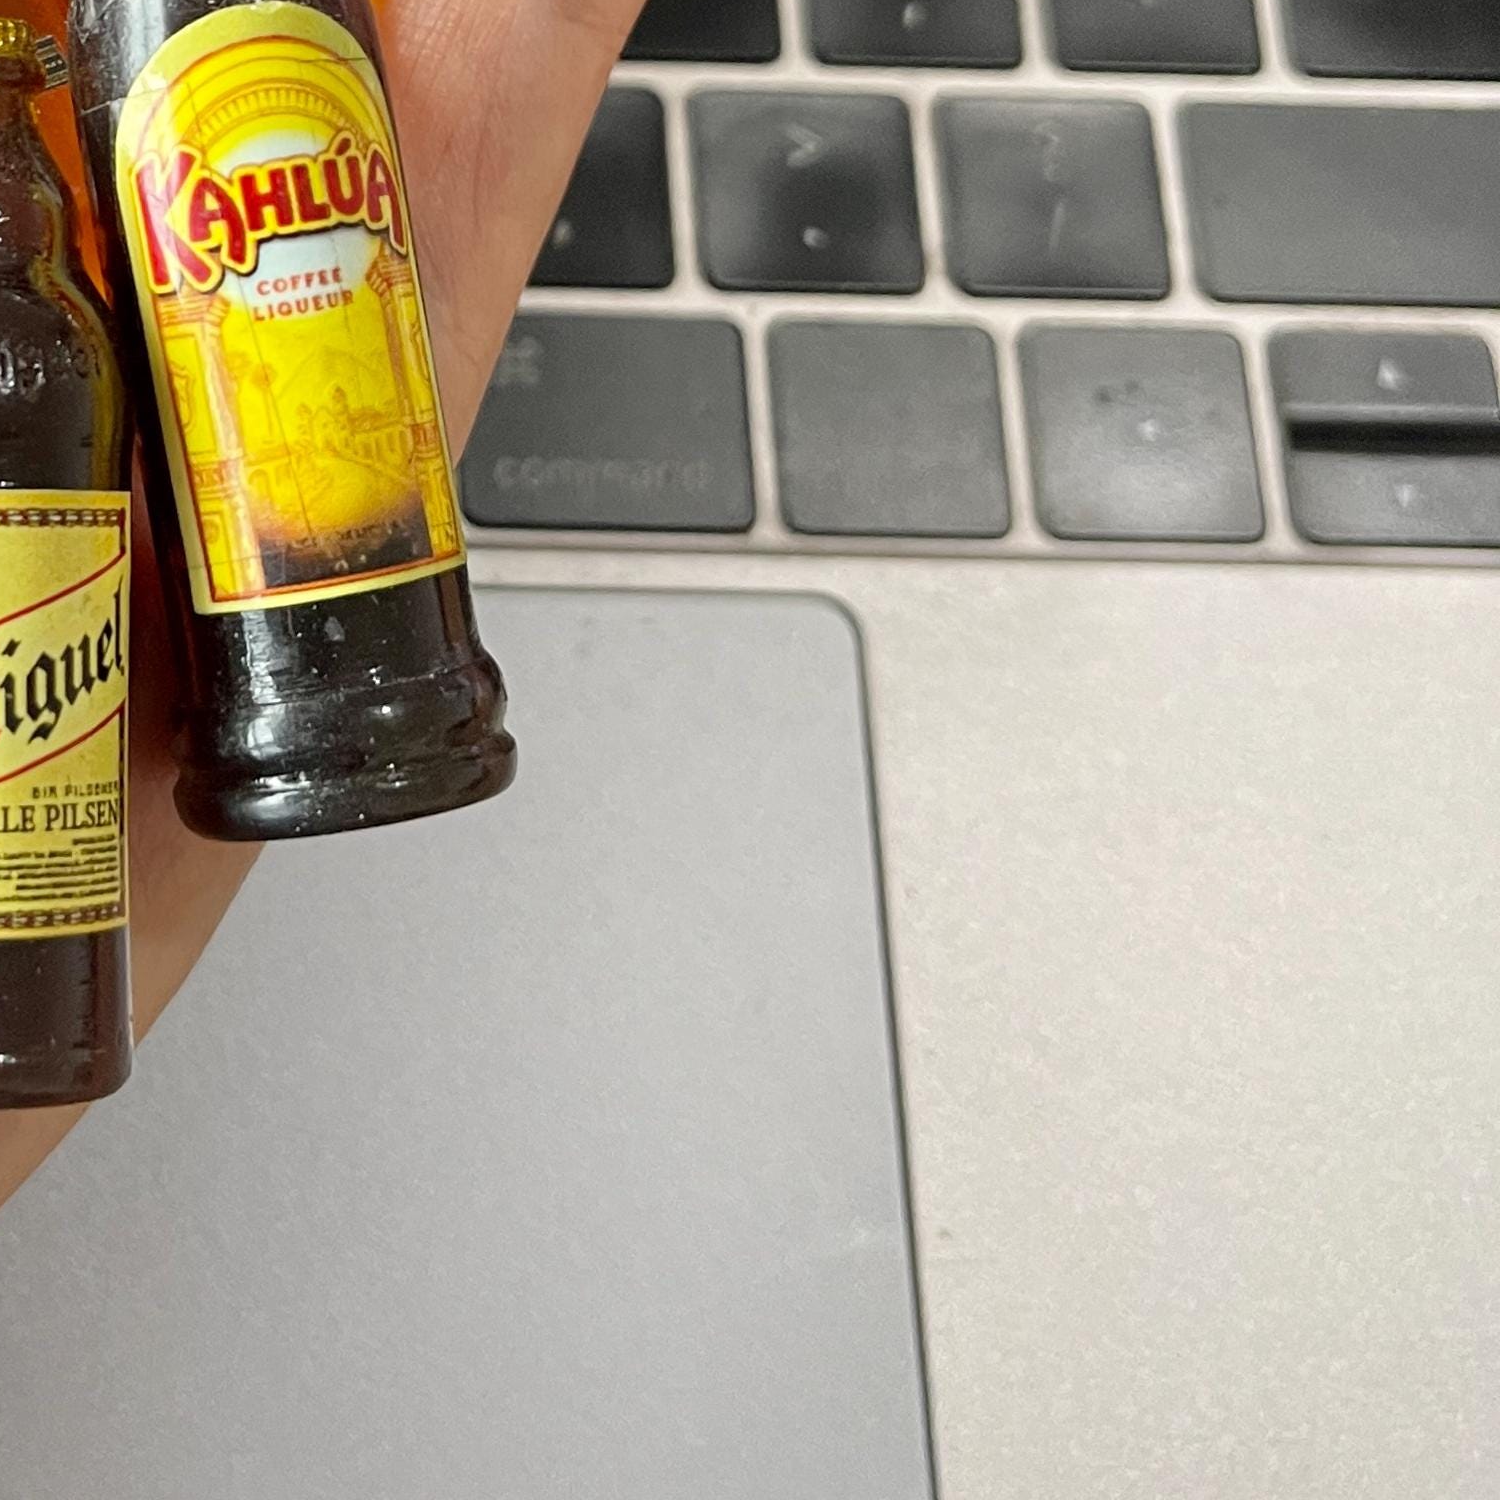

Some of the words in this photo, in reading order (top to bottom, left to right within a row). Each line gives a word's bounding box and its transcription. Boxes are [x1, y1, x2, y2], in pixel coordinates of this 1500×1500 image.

[134, 134, 408, 290] KAHLÚA
[255, 265, 344, 297] COFFEE
[252, 288, 355, 323] LIQUEUR
[43, 797, 120, 832] PILSEN
